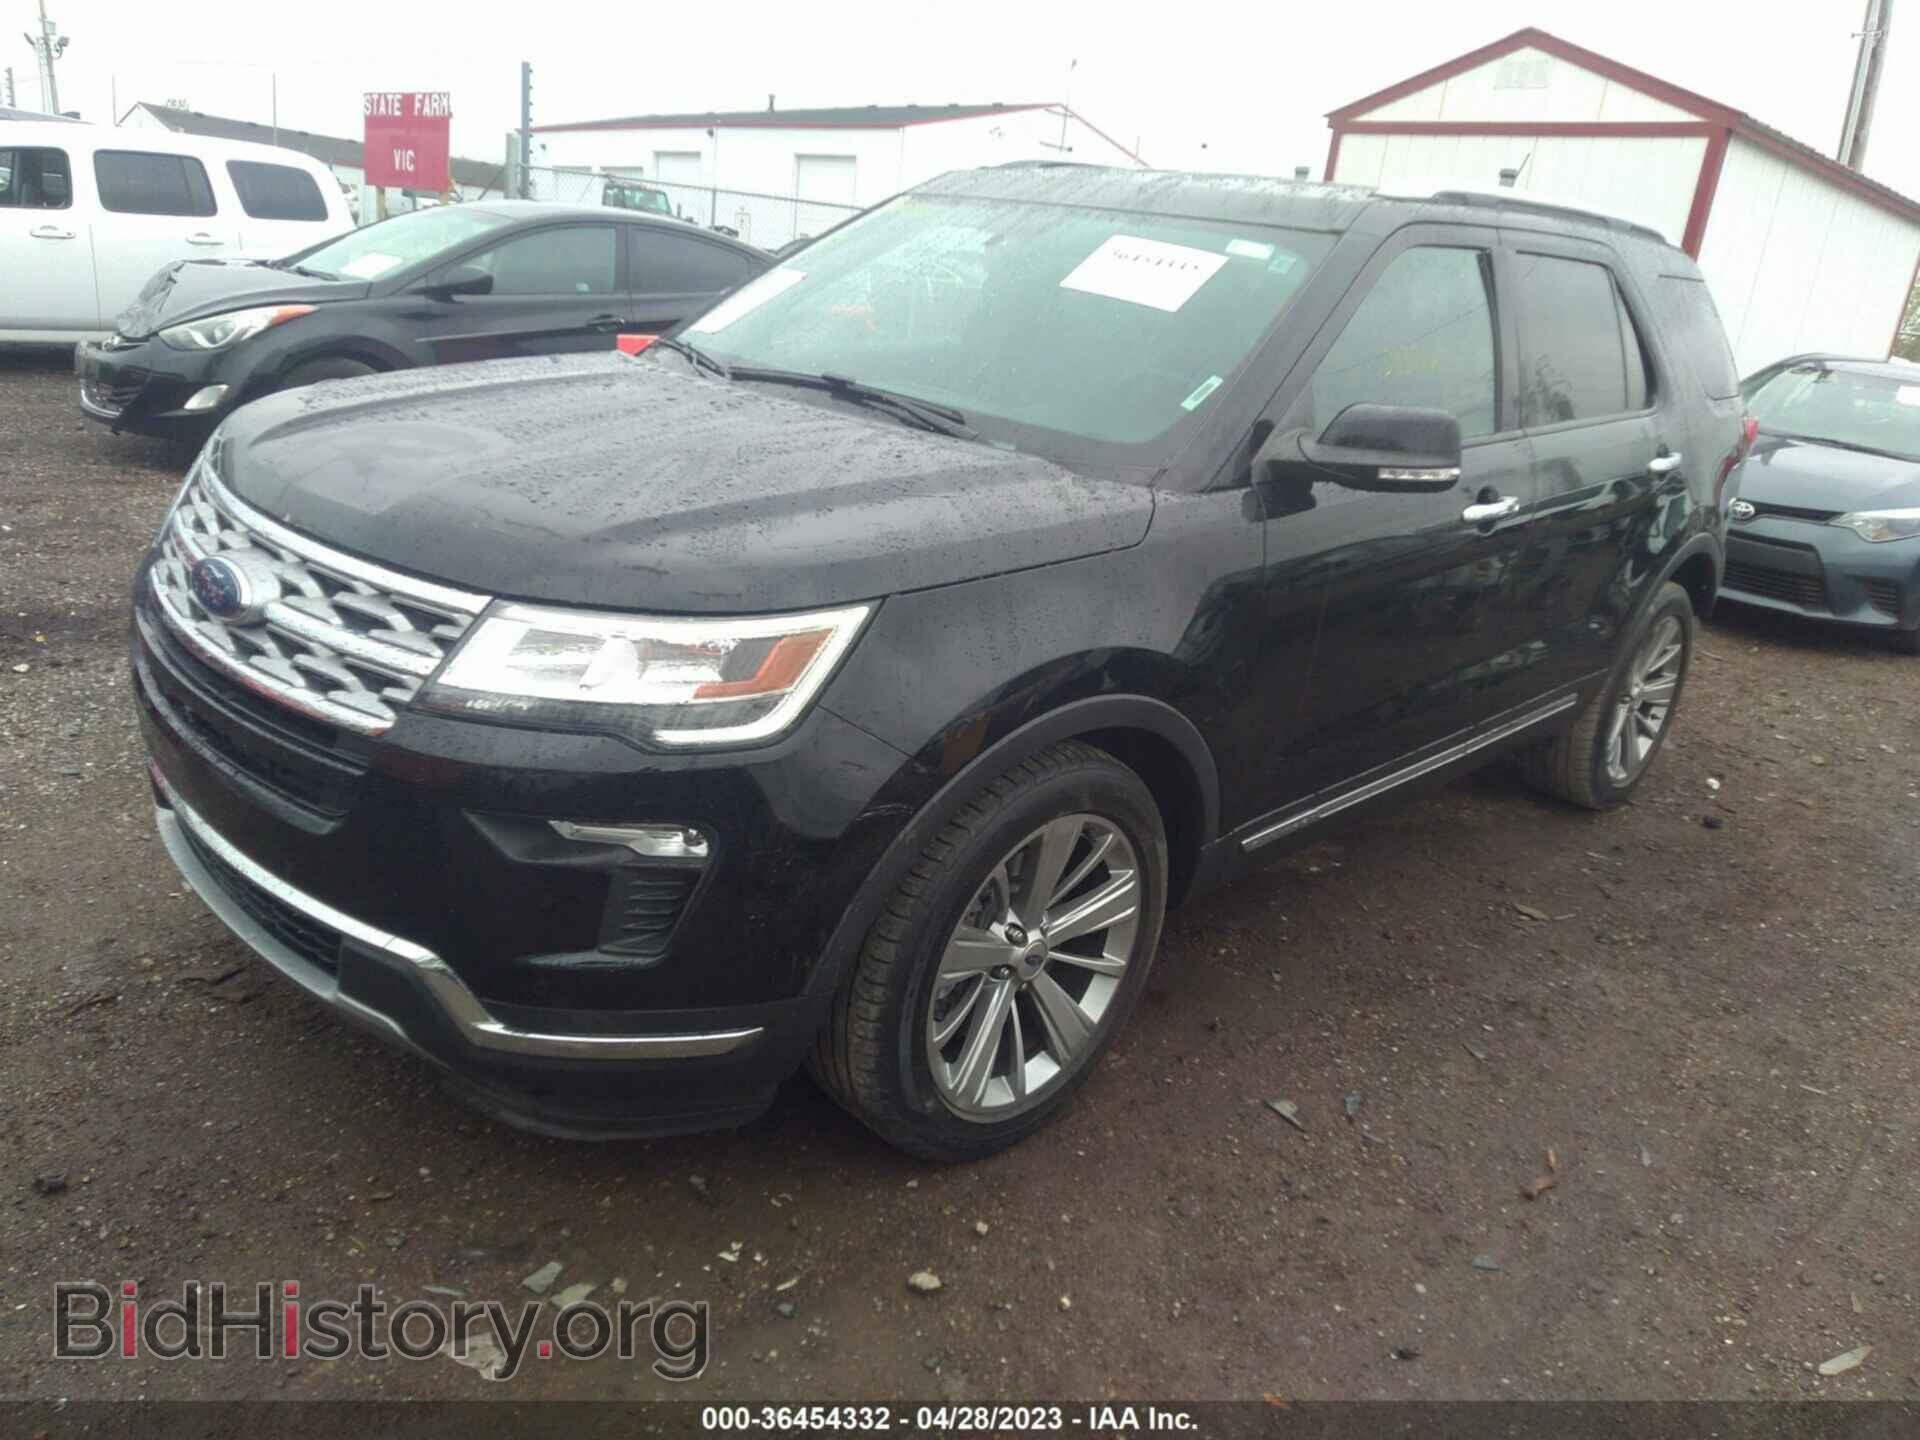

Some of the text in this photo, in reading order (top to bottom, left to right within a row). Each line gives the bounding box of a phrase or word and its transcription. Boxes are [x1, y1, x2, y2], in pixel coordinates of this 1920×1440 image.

[364, 93, 450, 117] STATE FARM
[393, 148, 416, 172] VIC
